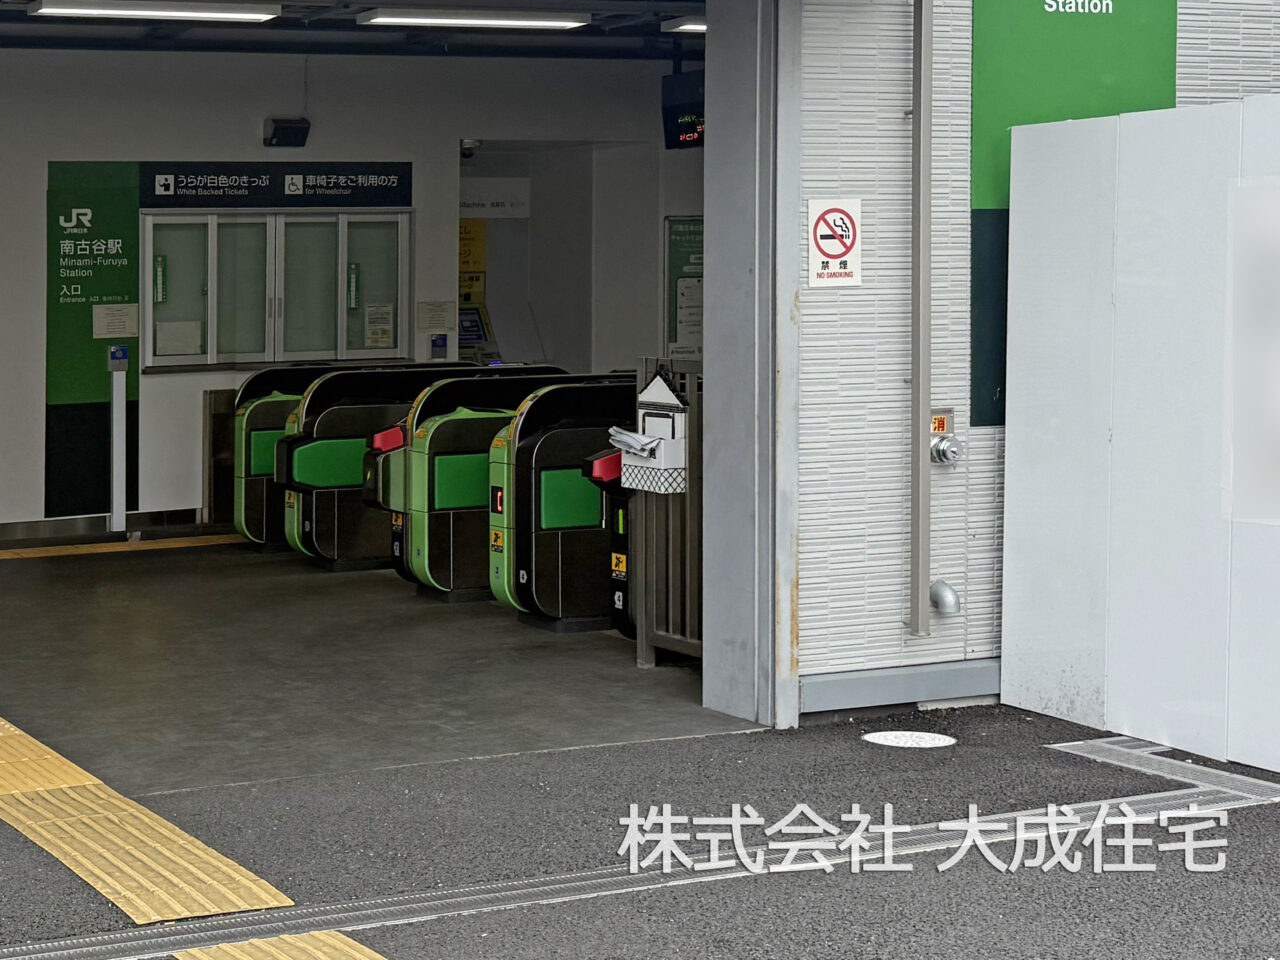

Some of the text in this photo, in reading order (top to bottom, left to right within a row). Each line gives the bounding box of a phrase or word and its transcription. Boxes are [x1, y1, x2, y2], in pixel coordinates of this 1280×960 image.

[305, 174, 399, 187] 車椅子をご利用の方
[59, 208, 92, 228] JR
[59, 239, 123, 255] 南古谷駅
[59, 256, 128, 267] Minami-Furuya
[821, 260, 848, 270] 禁煙
[59, 268, 93, 278] Station
[59, 284, 81, 296] 入口
[933, 416, 946, 432] 消
